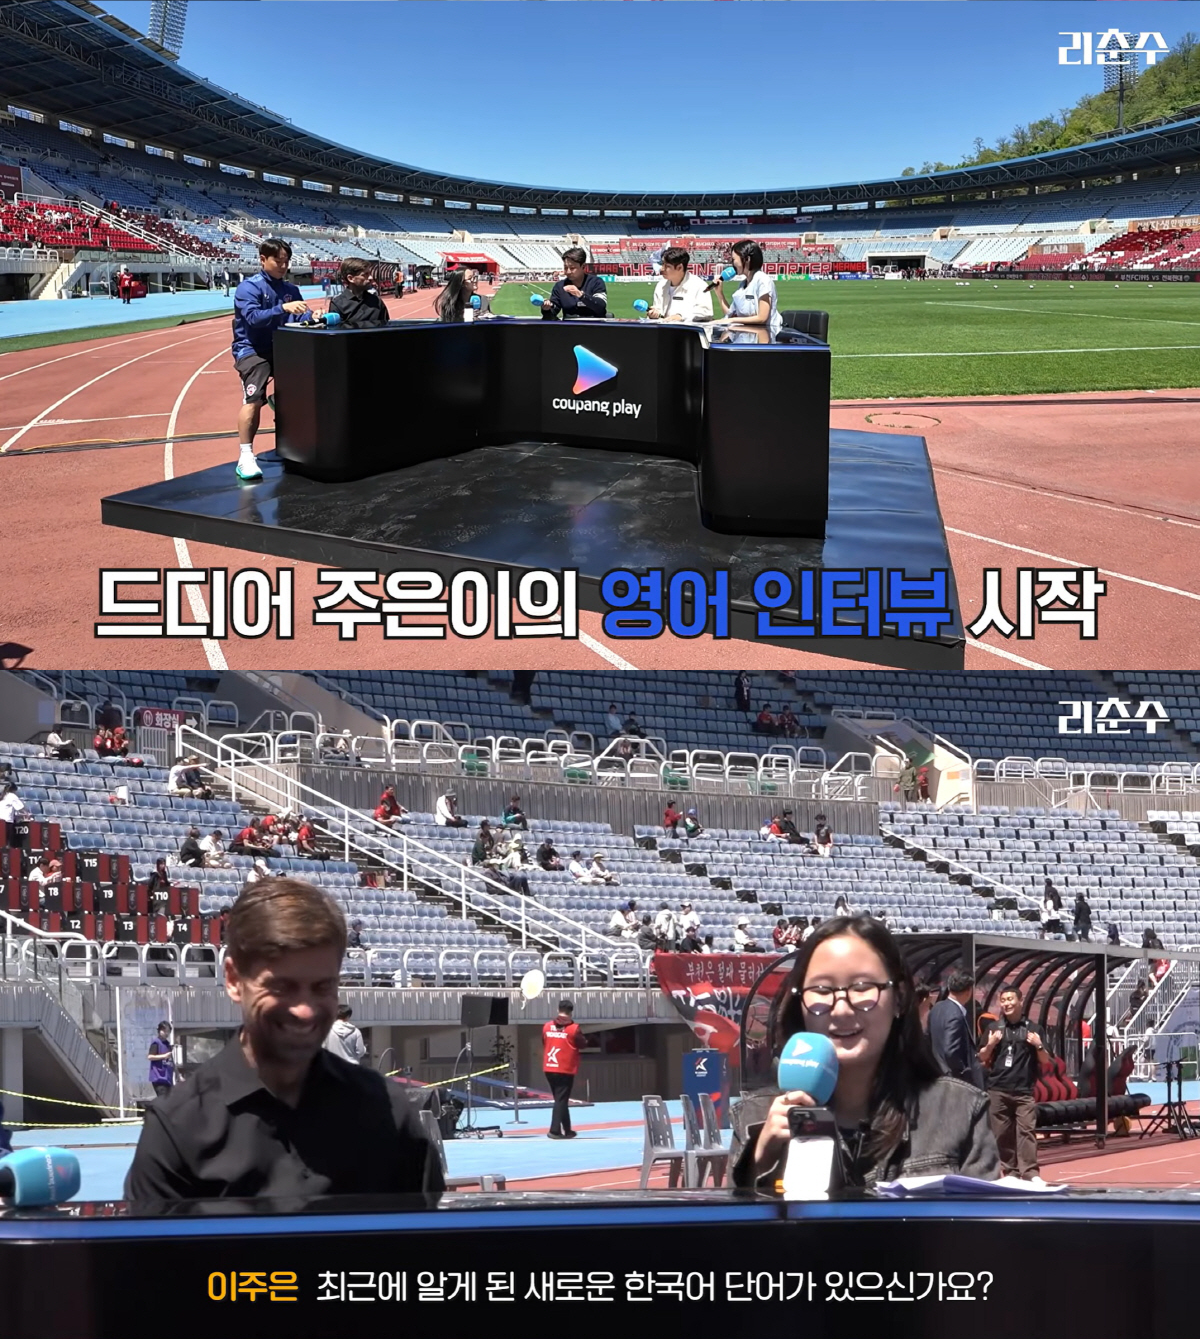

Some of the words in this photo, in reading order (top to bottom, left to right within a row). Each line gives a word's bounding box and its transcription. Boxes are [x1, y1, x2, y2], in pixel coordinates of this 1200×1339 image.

[552, 398, 610, 416] coupang
[613, 398, 642, 419] play
[155, 712, 179, 729] 화장실
[84, 859, 98, 868] T15
[48, 887, 59, 896] T8
[103, 890, 114, 899] T9
[154, 891, 168, 901] T10
[70, 920, 81, 929] T2
[123, 922, 134, 931] T3
[177, 923, 188, 932] T4
[738, 961, 767, 985] 물러서
